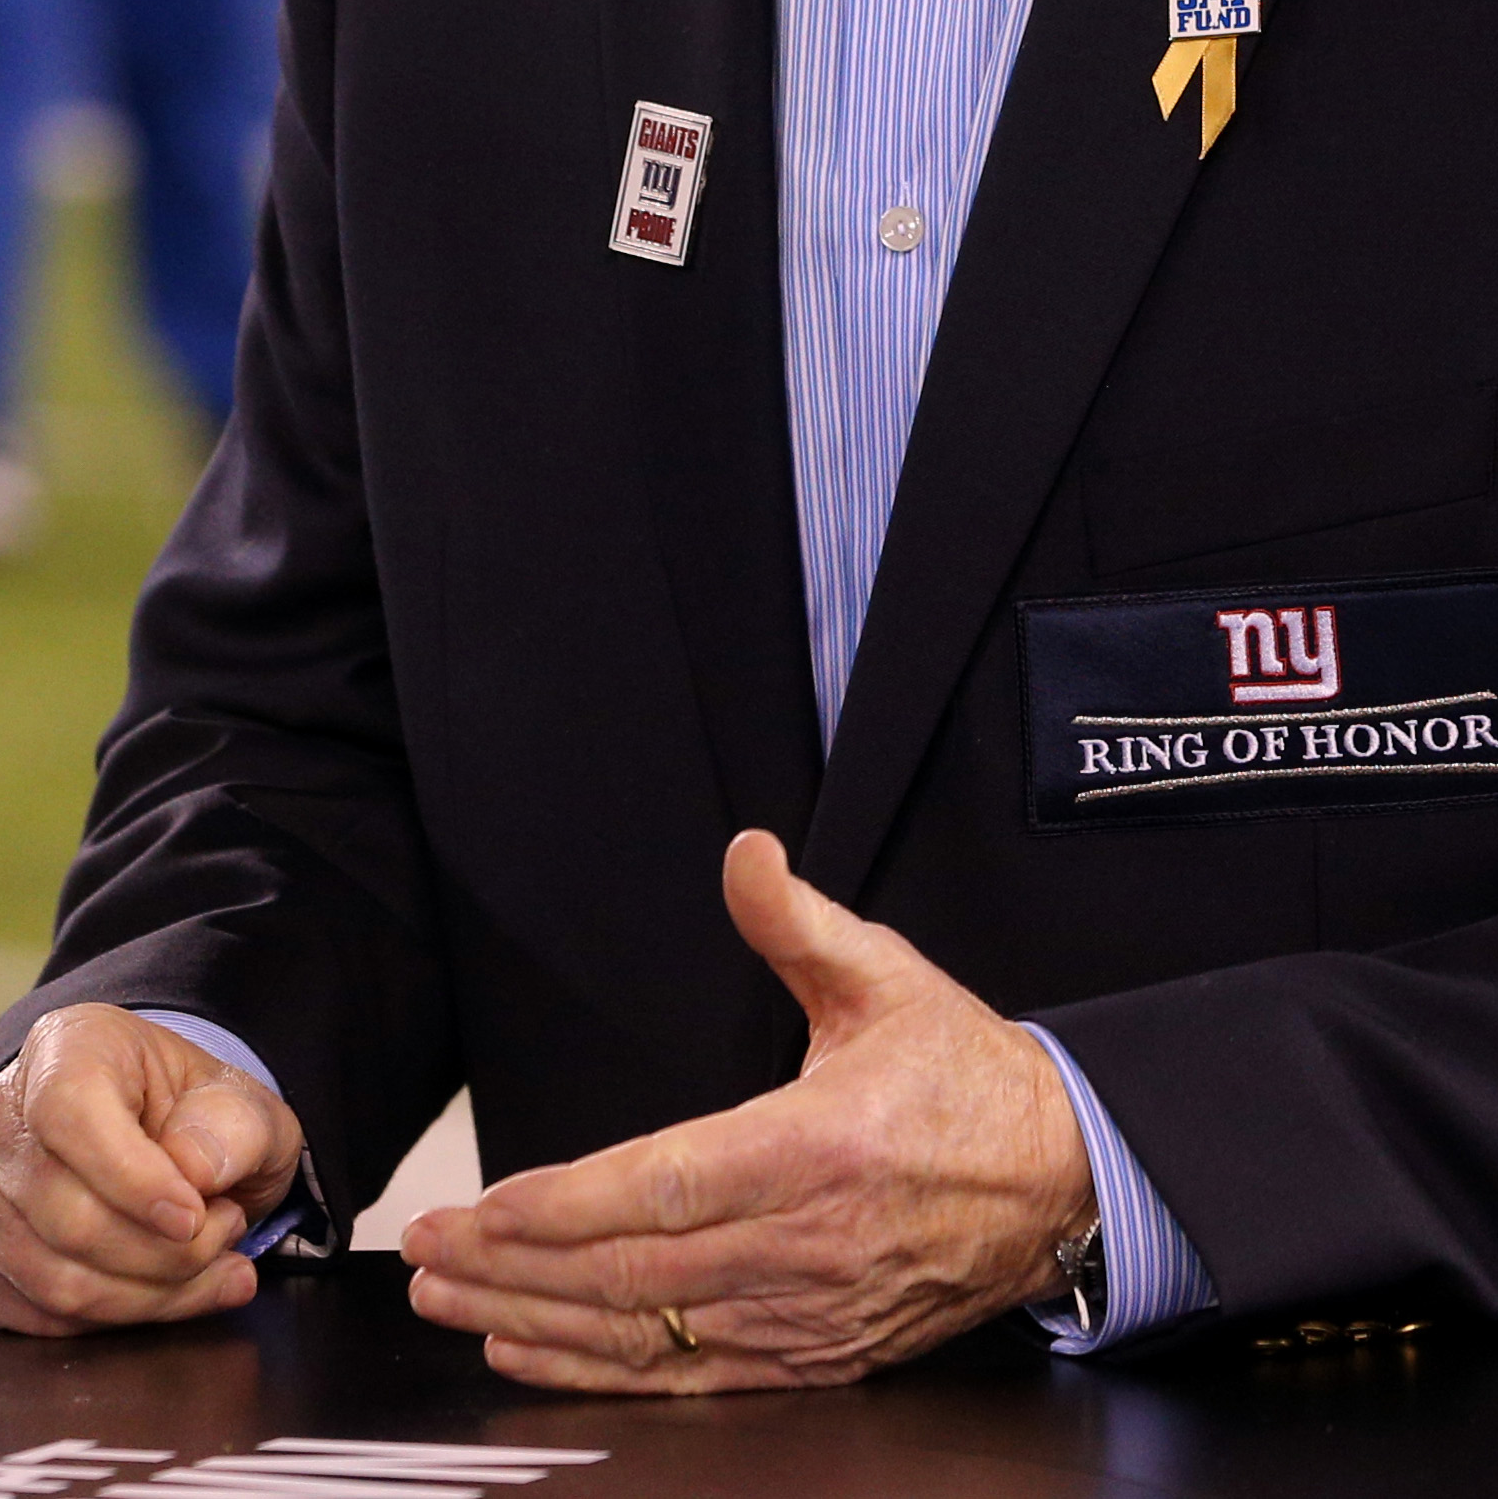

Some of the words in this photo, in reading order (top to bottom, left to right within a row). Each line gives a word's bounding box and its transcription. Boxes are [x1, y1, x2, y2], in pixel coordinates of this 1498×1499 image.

[1177, 7, 1251, 33] FUND
[638, 118, 700, 160] GIANTS
[1078, 731, 1209, 776] RING
[1221, 725, 1290, 763] OF
